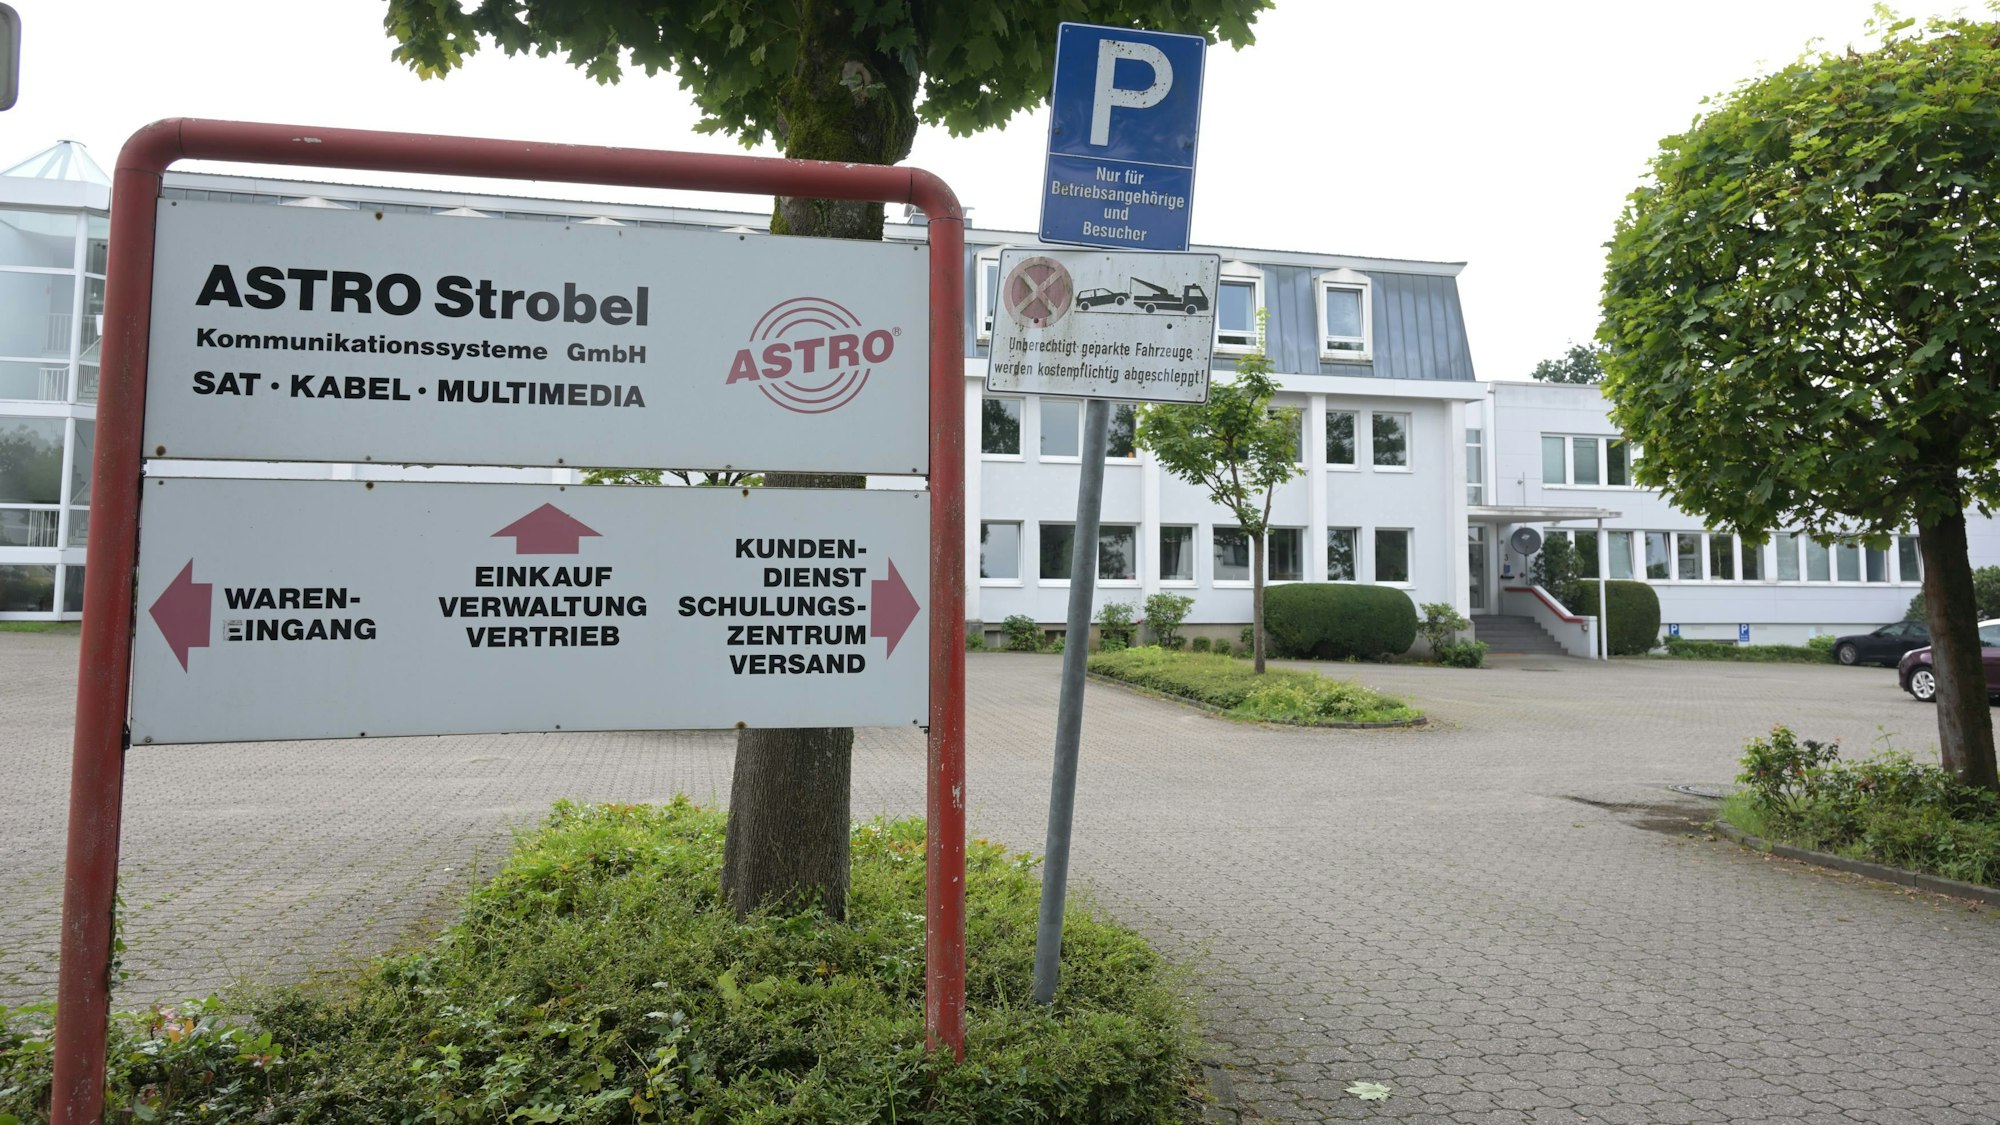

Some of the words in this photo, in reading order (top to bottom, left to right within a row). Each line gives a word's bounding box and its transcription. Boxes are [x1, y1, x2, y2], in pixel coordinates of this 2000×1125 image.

[1090, 39, 1173, 146] P
[1096, 167, 1120, 182] Nur
[1125, 169, 1144, 185] für
[1052, 180, 1185, 210] Betriebsangehörige
[1104, 207, 1129, 220] und
[1083, 221, 1147, 241] Besucher
[195, 265, 421, 316] ASTRO
[435, 275, 649, 326] Strobel
[196, 328, 548, 361] Kommunikationssysteme
[567, 343, 646, 363] GmbH
[1009, 337, 1077, 357] Unberechtigt
[1081, 341, 1130, 358] geparkte
[1135, 342, 1193, 361] Fahrzeuge
[994, 361, 1033, 376] werden
[1038, 362, 1119, 383] kostenpflichtig
[1124, 367, 1204, 387] abgeschleppt!
[193, 371, 262, 396] SAT
[290, 375, 411, 401] KABEL
[437, 379, 646, 408] MULTIMEDIA
[735, 538, 867, 559] KUNDEN-
[475, 566, 613, 588] EINKAUF
[763, 567, 867, 588] DIENST
[224, 587, 361, 609] WAREN-
[438, 595, 647, 618] VERWALTUNG
[678, 595, 867, 617] SCHULUNGS-
[224, 618, 377, 641] EINGANG
[466, 625, 620, 647] VERTRIEB
[727, 624, 866, 646] ZENTRUM
[729, 653, 866, 675] VERSAND
